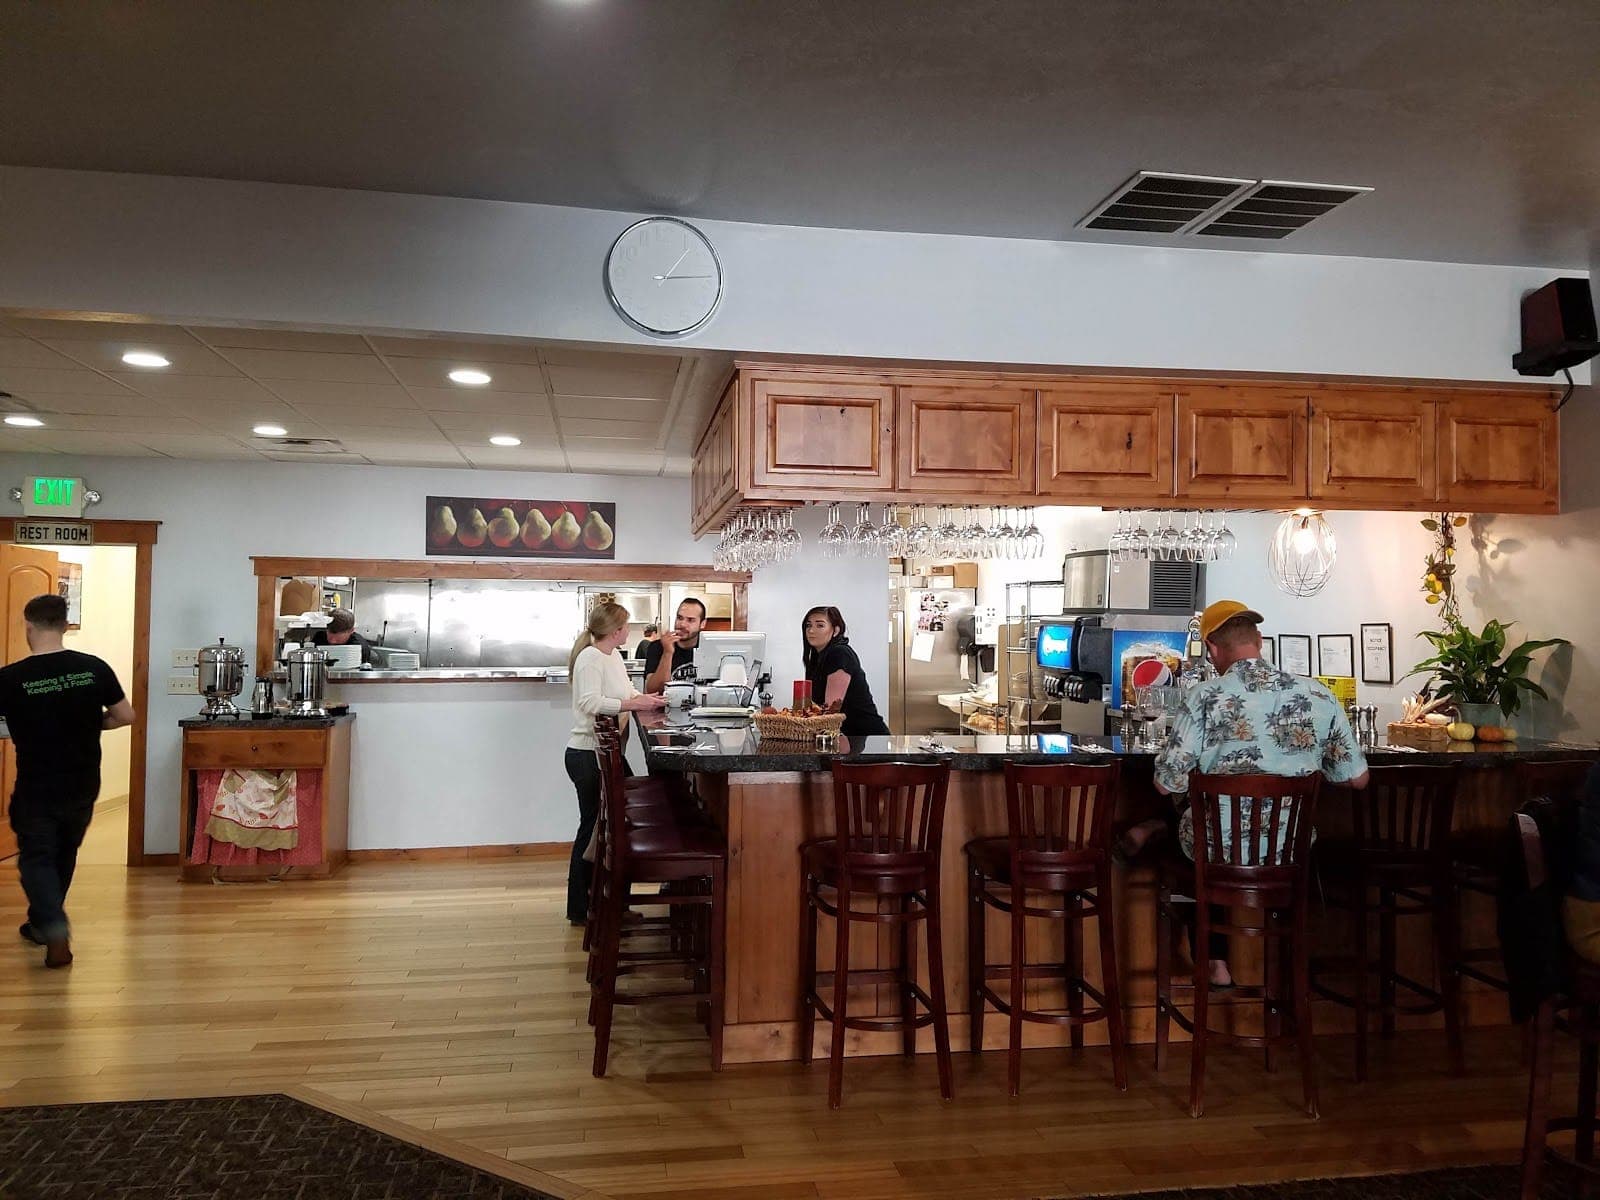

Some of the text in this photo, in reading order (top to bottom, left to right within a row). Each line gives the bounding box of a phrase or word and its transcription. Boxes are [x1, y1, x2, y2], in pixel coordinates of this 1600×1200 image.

[34, 478, 75, 505] EXIT
[20, 526, 88, 540] REST ROOM
[22, 677, 58, 689] Keeping
[27, 684, 63, 695] Keeping
